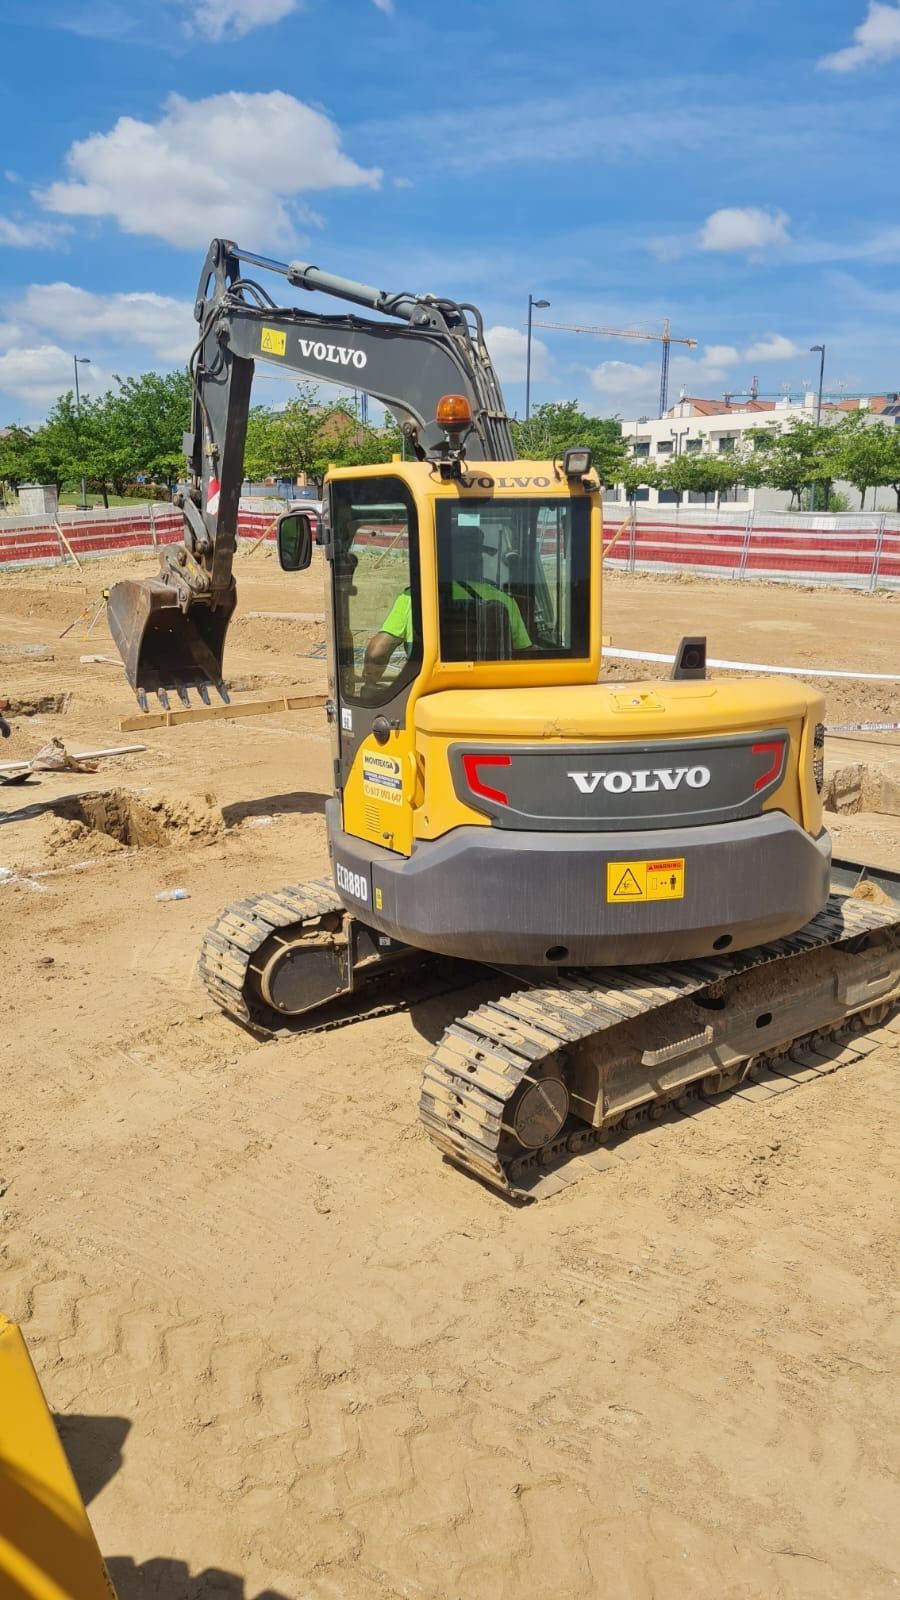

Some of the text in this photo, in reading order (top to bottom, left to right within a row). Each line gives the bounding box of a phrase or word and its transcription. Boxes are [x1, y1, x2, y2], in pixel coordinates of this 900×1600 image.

[298, 339, 367, 369] VOLVO
[460, 476, 551, 489] VOLVO
[567, 765, 711, 794] VOLVO
[336, 863, 368, 902] ECR88D
